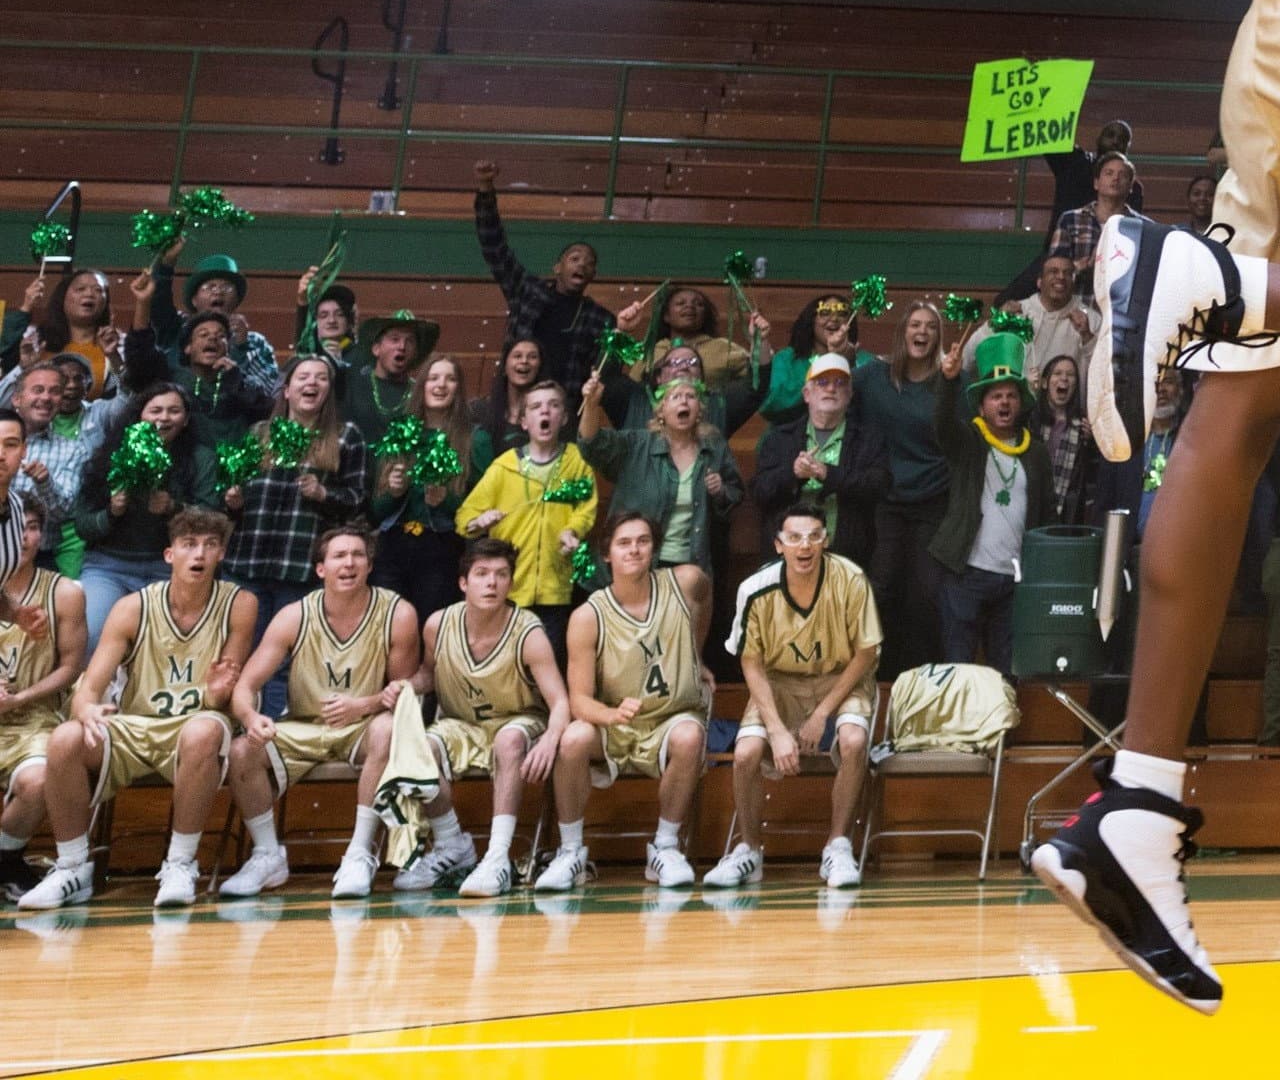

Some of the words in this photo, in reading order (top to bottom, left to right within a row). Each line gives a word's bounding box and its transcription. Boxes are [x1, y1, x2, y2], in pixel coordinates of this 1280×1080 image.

[991, 65, 1039, 96] LETS
[984, 111, 1076, 153] LEBRON
[637, 635, 663, 664] M
[789, 641, 822, 663] M
[168, 655, 193, 683] M
[325, 662, 352, 688] M
[645, 664, 670, 698] 4
